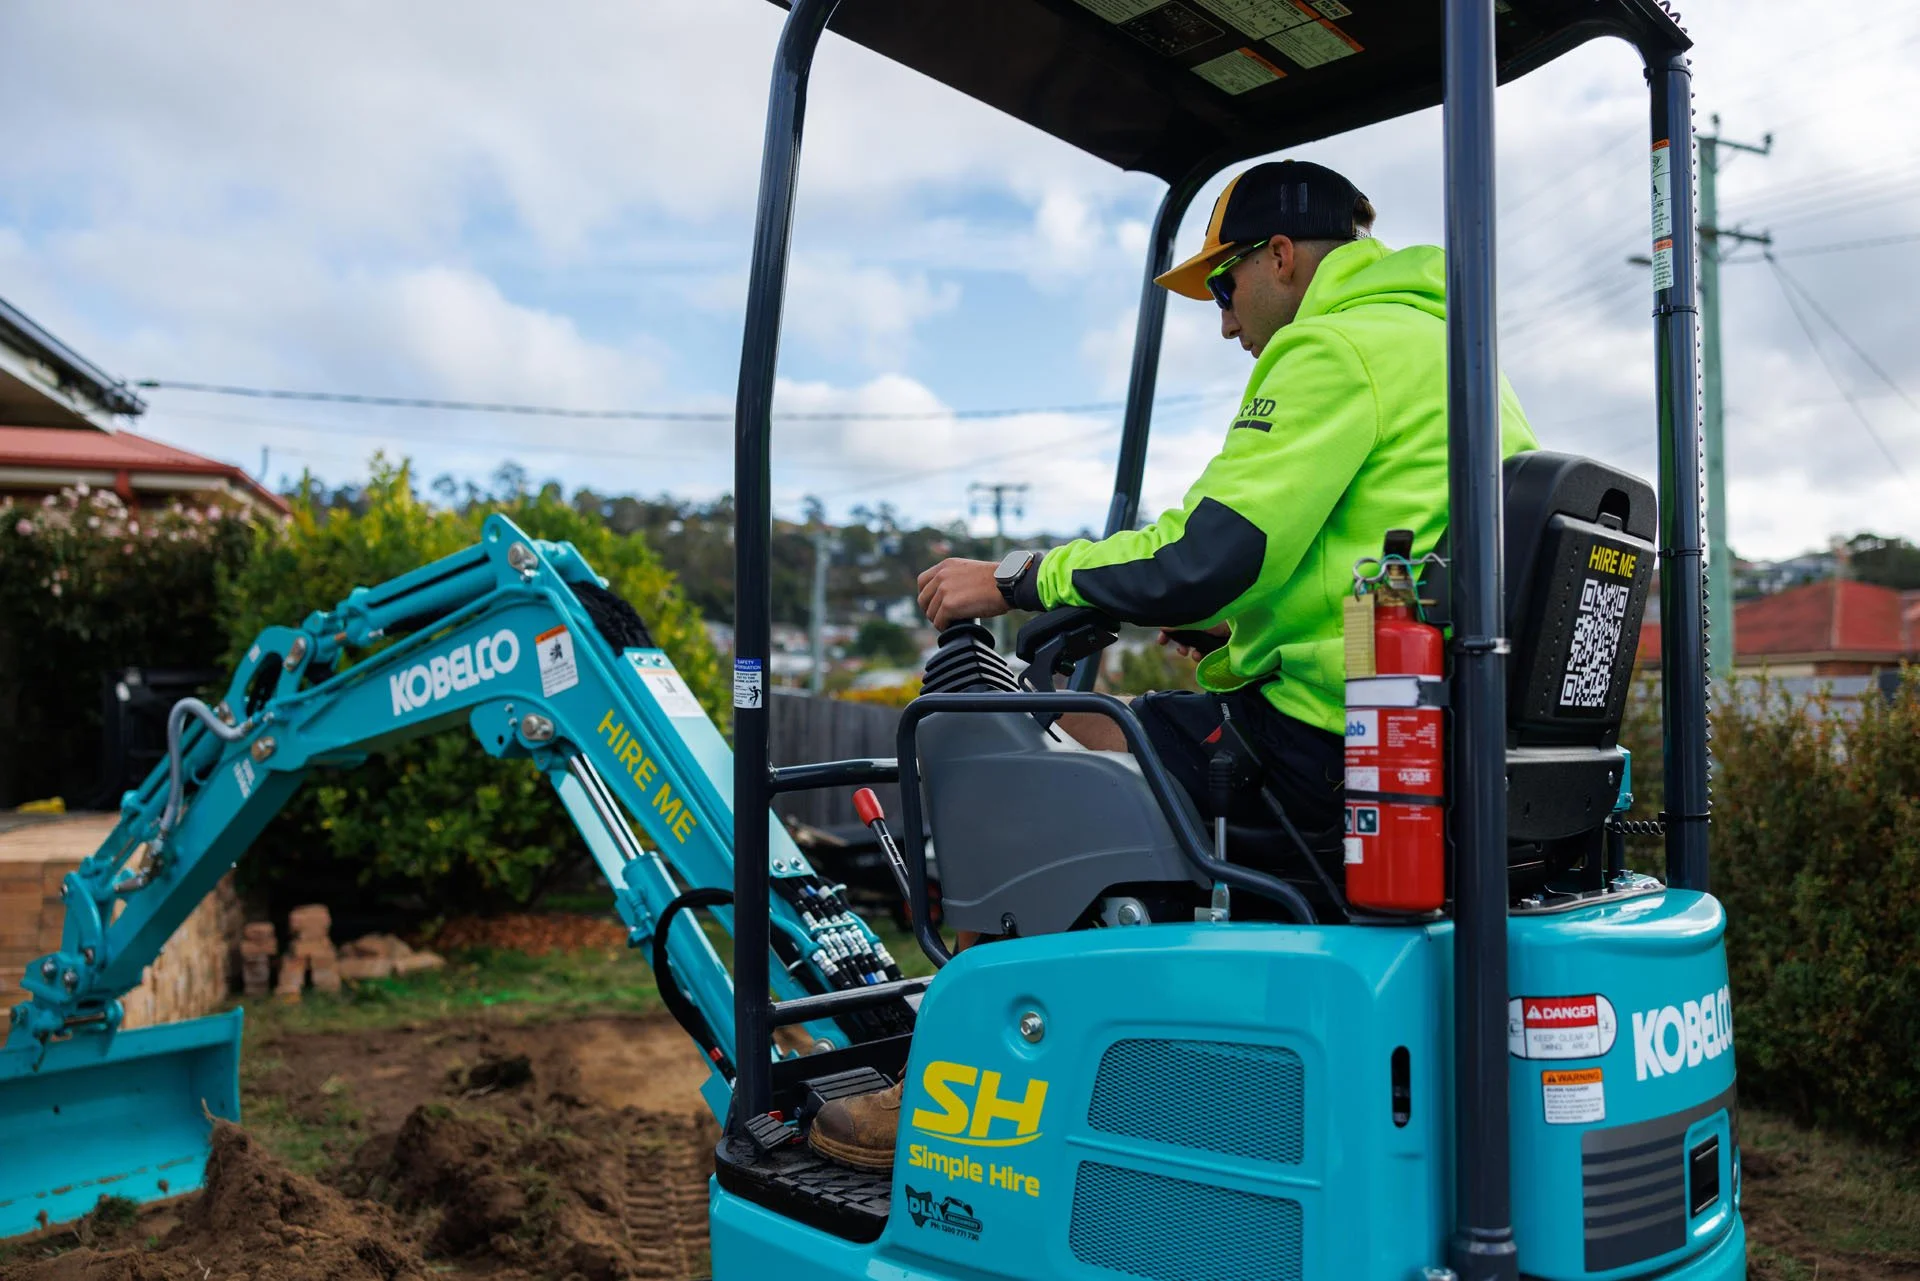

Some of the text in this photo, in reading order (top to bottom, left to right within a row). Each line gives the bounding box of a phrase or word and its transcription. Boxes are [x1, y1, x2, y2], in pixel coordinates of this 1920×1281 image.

[1588, 544, 1637, 578] HIRE ME
[389, 629, 520, 716] KOBELCO
[597, 710, 697, 844] HIRE ME
[1533, 1033, 1556, 1042] KEEP
[1542, 1005, 1596, 1020] DANGER
[1632, 983, 1733, 1081] KOBELCO
[912, 1061, 1049, 1137] SH
[1557, 1071, 1599, 1082] WARNING
[908, 1143, 1040, 1197] Simple Hire
